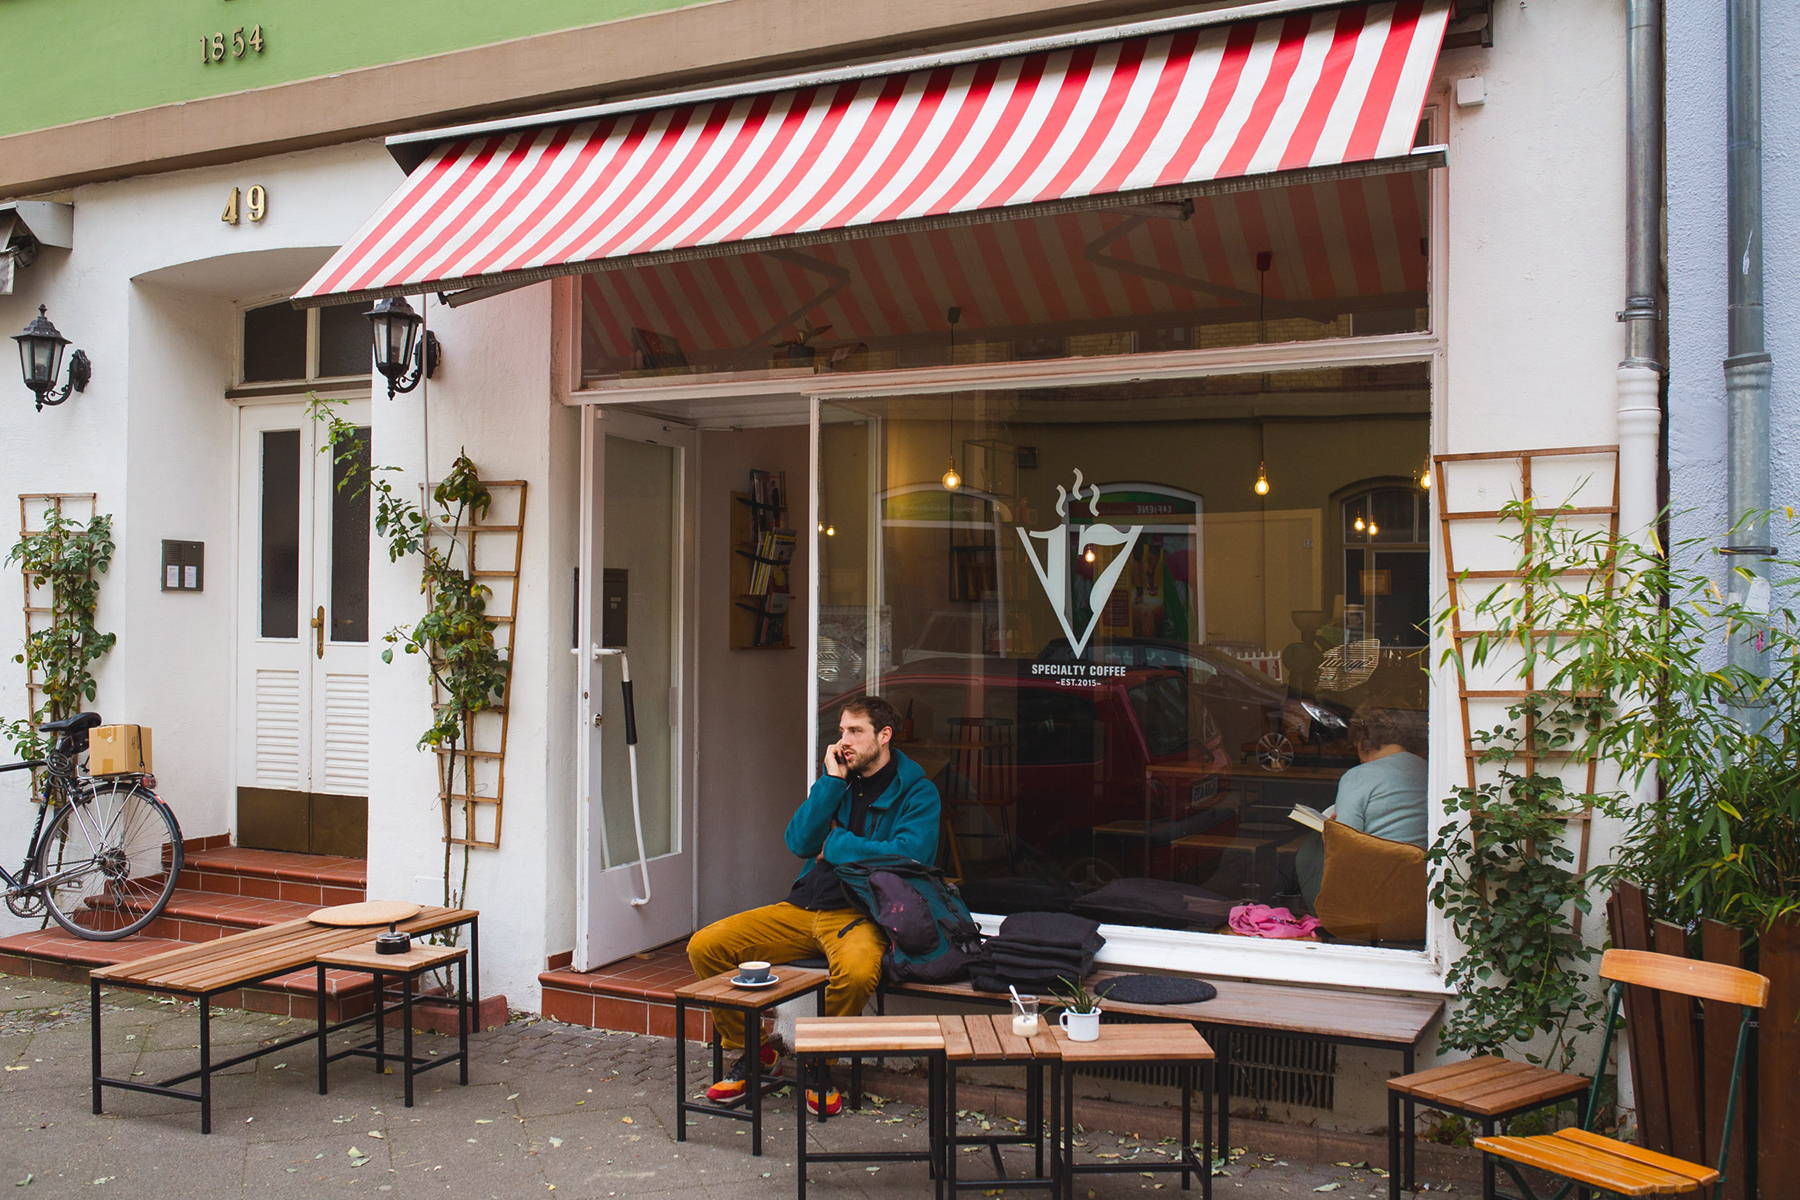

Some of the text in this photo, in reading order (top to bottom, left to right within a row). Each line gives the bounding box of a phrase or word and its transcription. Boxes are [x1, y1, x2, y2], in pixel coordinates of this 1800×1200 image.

[200, 23, 264, 64] 1854
[221, 184, 266, 225] 49
[1031, 664, 1126, 677] SPECIALTY COFFEE
